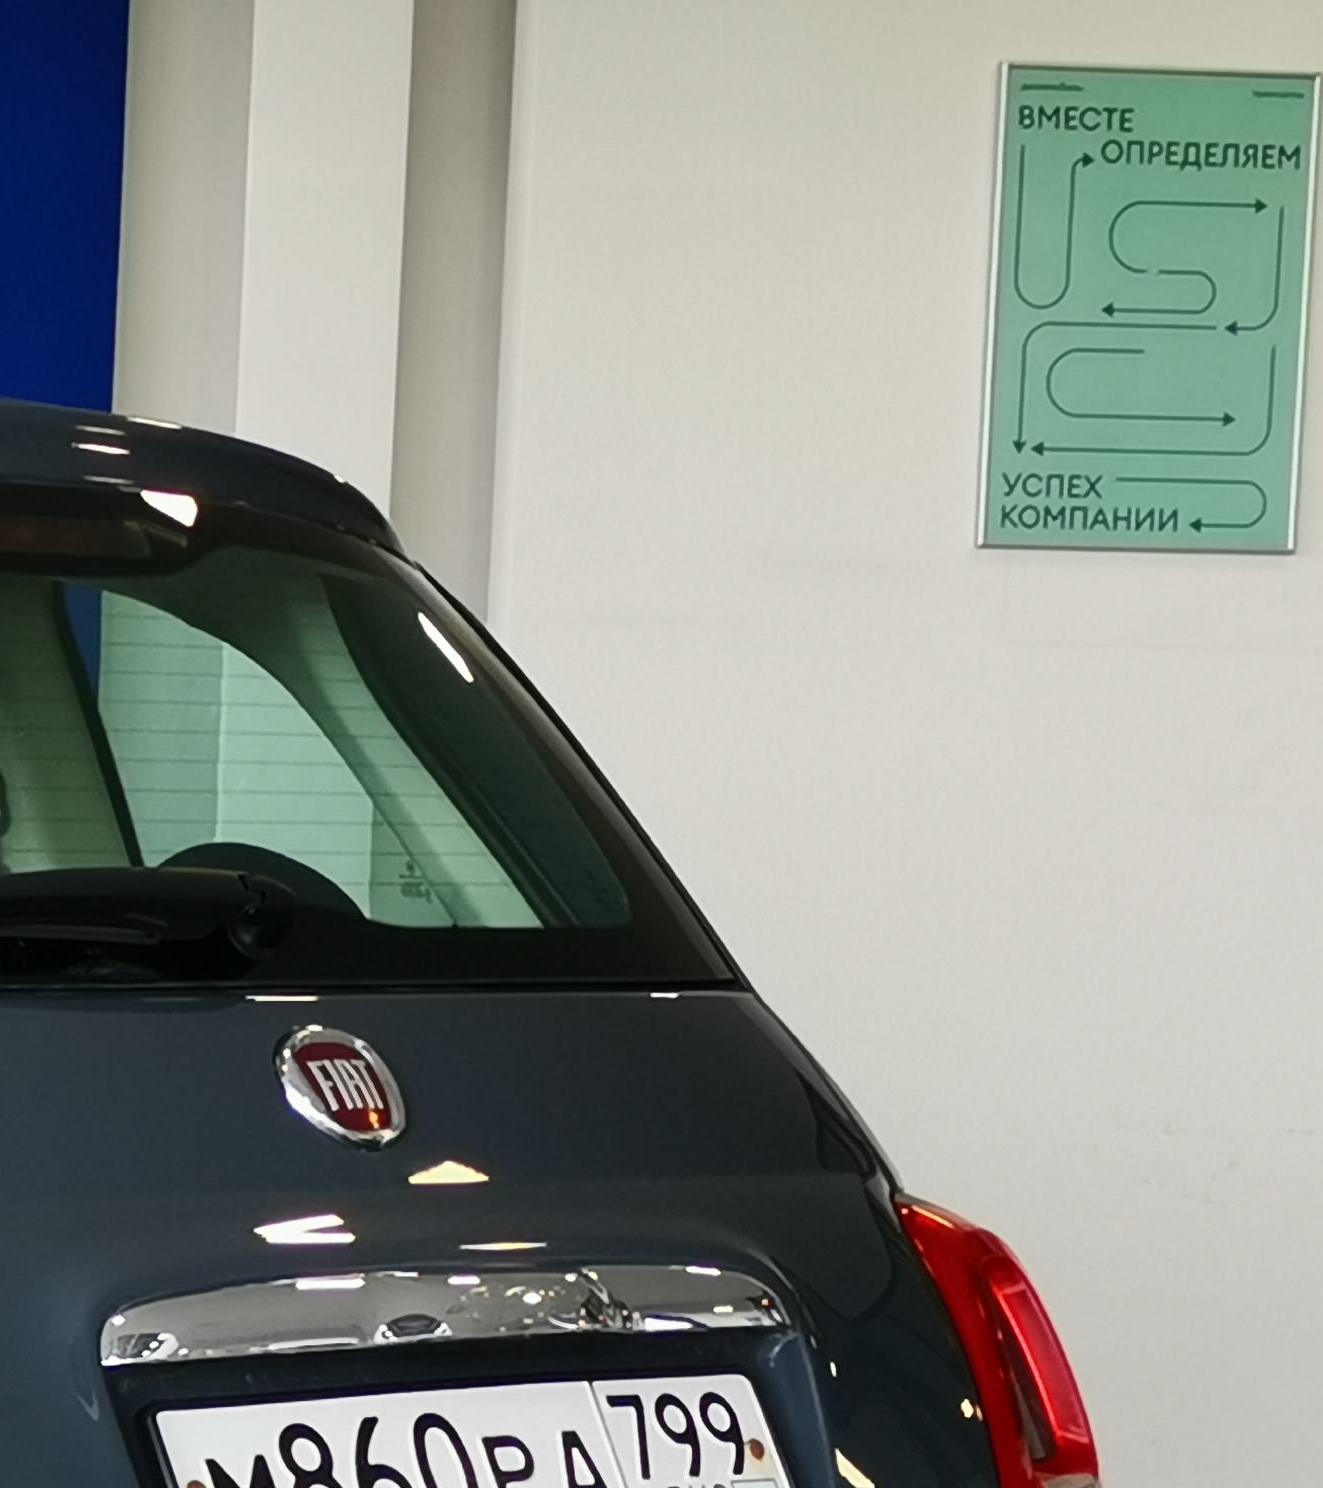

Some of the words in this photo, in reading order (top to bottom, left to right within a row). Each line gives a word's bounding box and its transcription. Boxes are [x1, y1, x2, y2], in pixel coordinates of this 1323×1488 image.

[1018, 105, 1135, 132] ВМЕСТЕ
[1101, 139, 1301, 171] ОПРЕДЕЛЯЕМ
[1002, 472, 1103, 498] УСПЕХ
[1000, 505, 1179, 533] КОМПАНИИ
[307, 1059, 384, 1111] FIAT
[606, 1392, 745, 1480] 799
